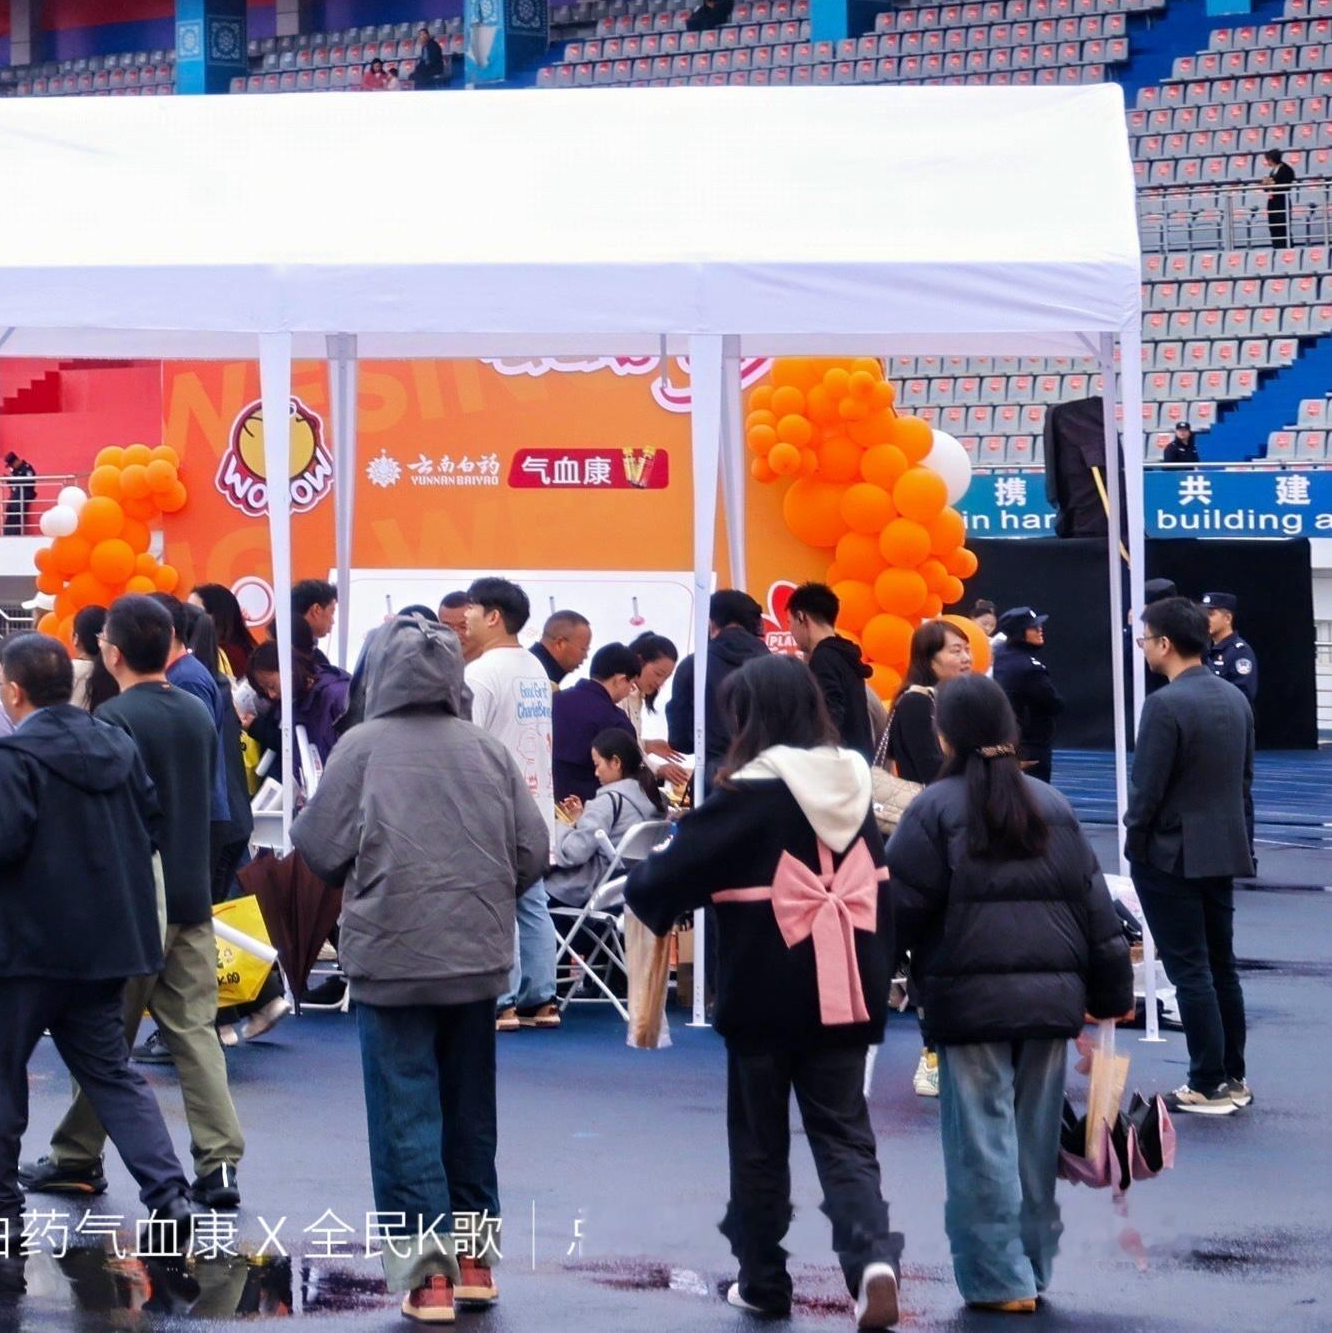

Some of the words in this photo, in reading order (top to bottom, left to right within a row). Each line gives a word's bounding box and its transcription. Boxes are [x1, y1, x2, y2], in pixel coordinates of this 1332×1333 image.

[223, 447, 333, 509] WOOW
[407, 453, 500, 475] 云南白药
[521, 456, 611, 485] 气血康
[1157, 510, 1303, 534] building
